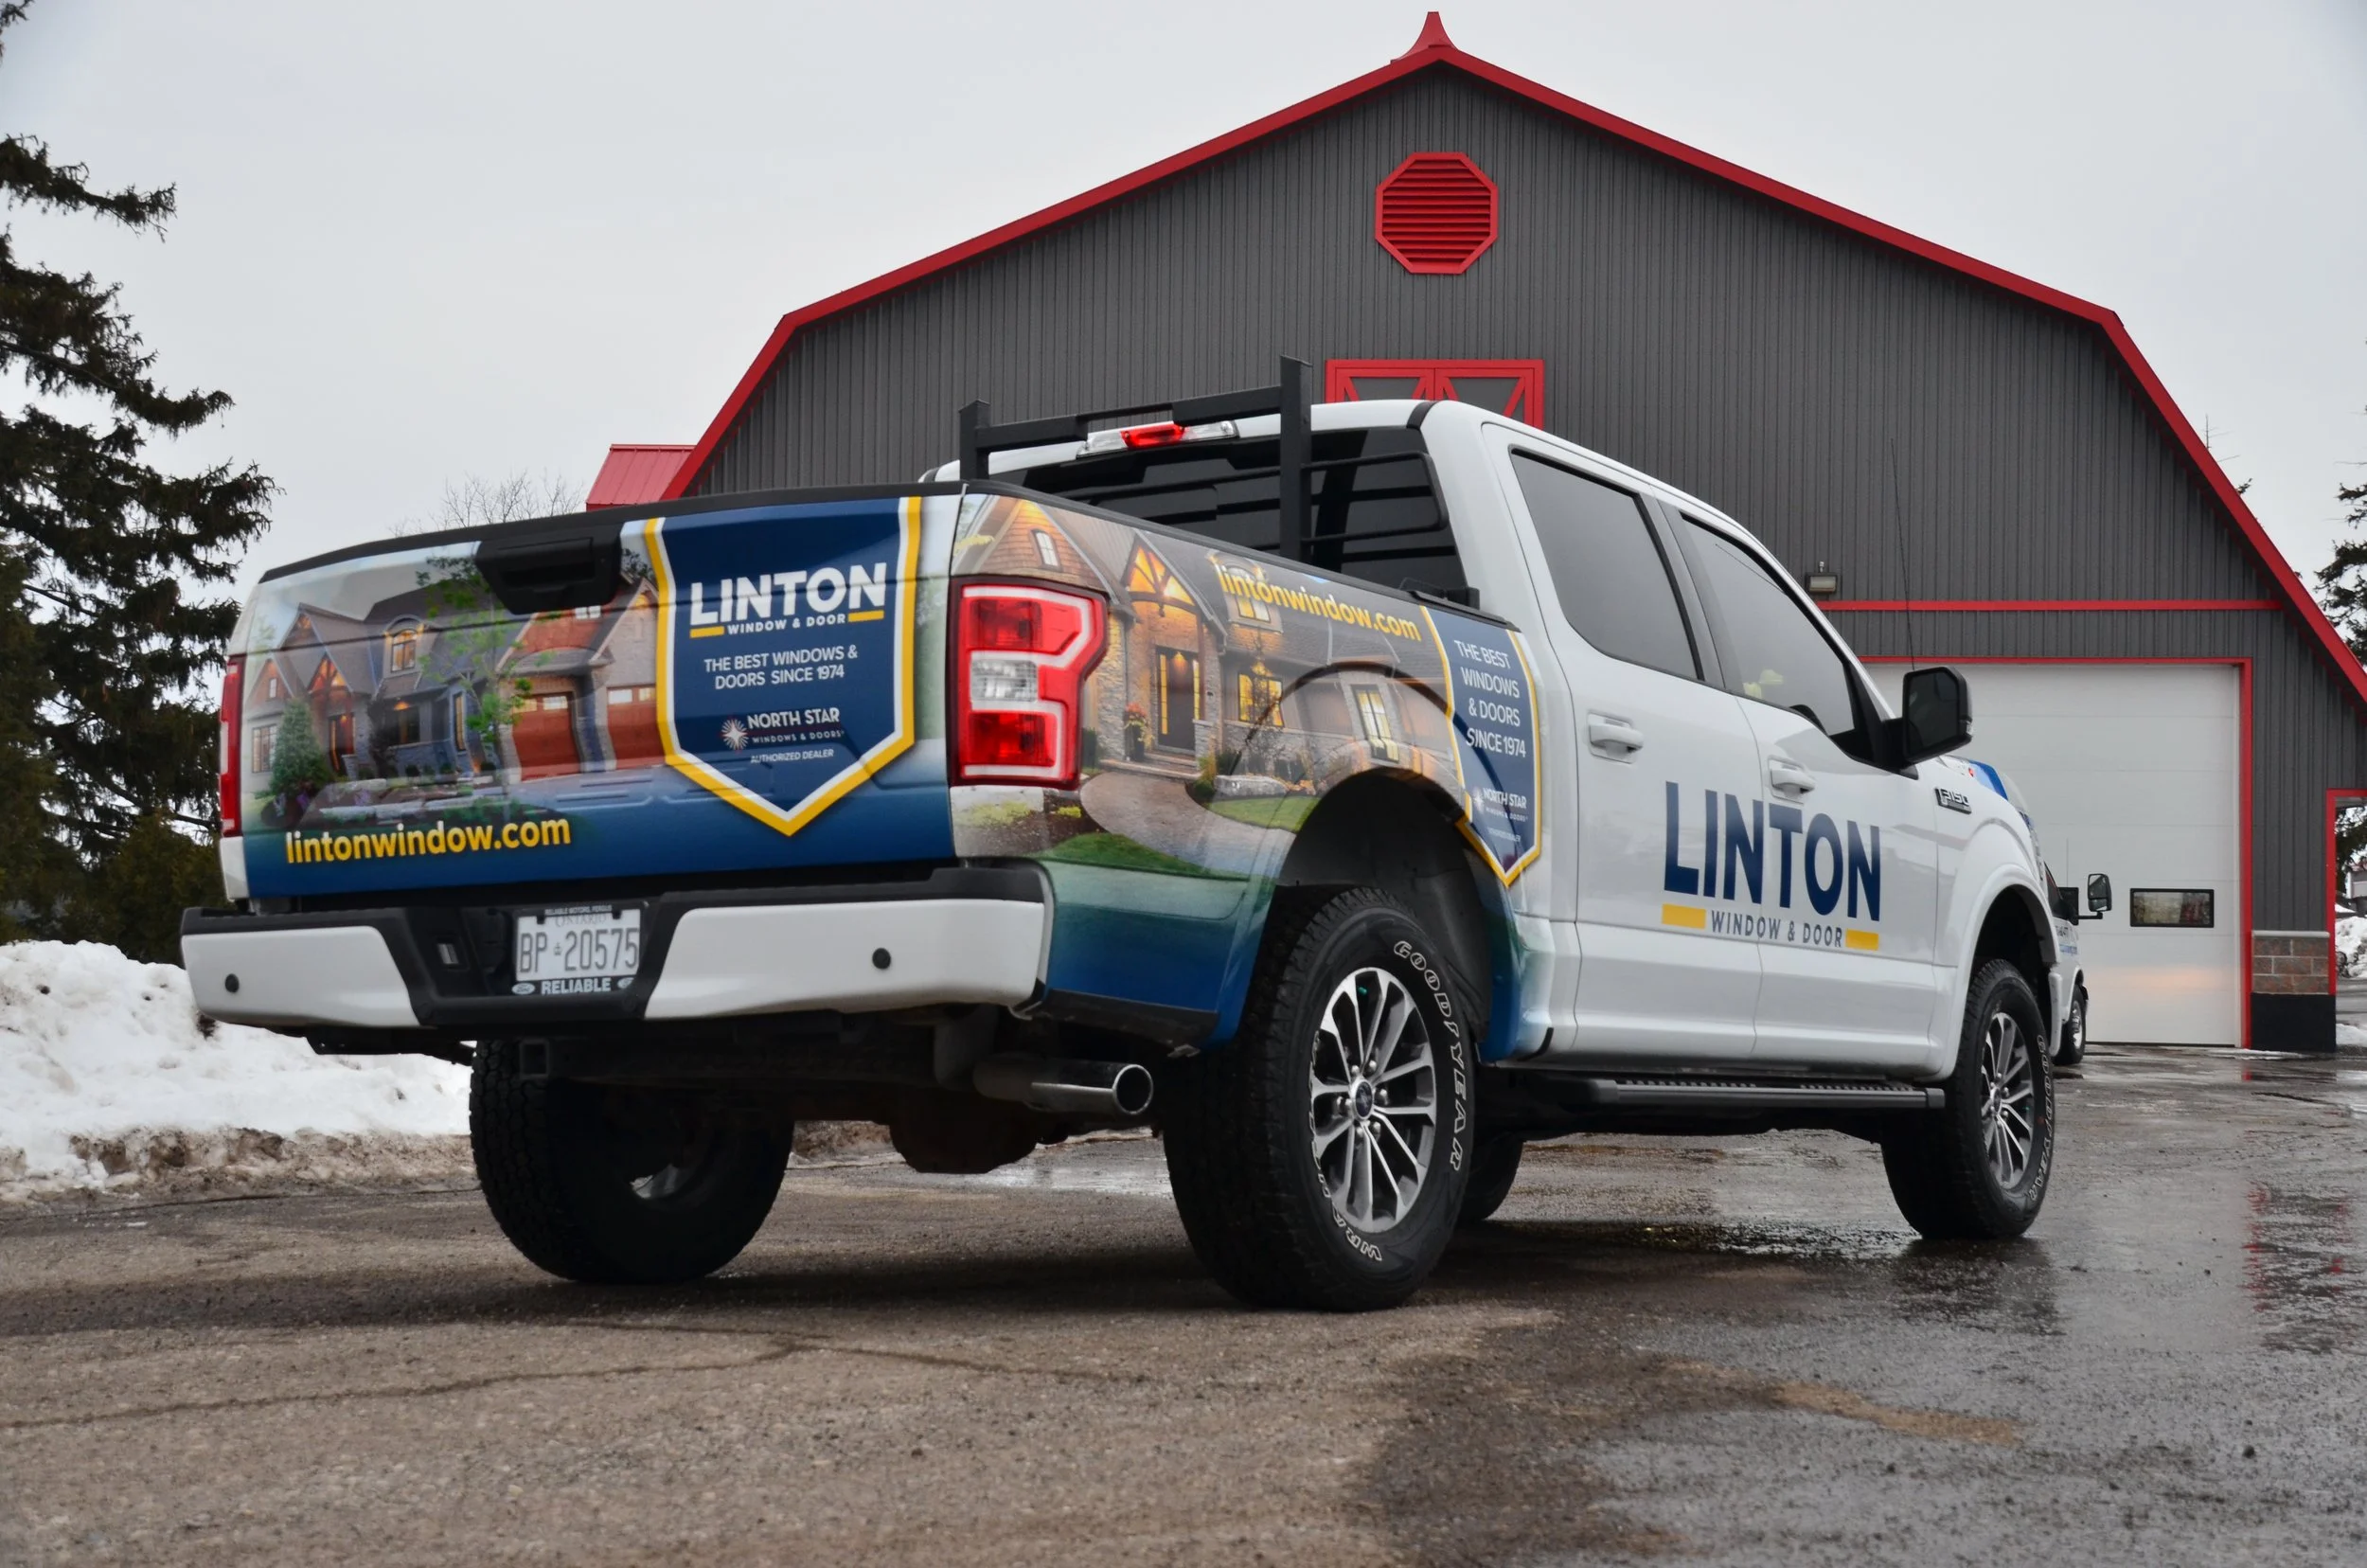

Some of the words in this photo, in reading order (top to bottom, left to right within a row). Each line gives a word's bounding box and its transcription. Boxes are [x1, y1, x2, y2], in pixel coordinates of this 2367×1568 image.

[690, 562, 886, 626] LINTON
[1216, 563, 1422, 641] lintonwindow.com
[727, 618, 787, 635] WINDOW
[792, 617, 801, 629] &
[807, 614, 846, 627] DOOR
[703, 656, 731, 672] THE
[734, 653, 770, 669] BEST
[772, 646, 845, 666] WINDOWS
[847, 644, 858, 659] &
[1453, 639, 1483, 663] THE
[1480, 647, 1511, 669] BEST
[715, 671, 766, 690] DOORS
[771, 667, 813, 685] SINCE
[816, 664, 845, 680] 1974
[1460, 666, 1521, 699] WINDOWS
[747, 710, 802, 730] NORTH
[804, 707, 840, 725] STAR
[1468, 697, 1477, 717] &
[1479, 700, 1521, 727] DOORS
[752, 733, 797, 743] WINDOWS
[1466, 727, 1503, 754] SINCE
[1503, 735, 1526, 758] 1974
[750, 751, 800, 764] AUTHORIZED
[802, 748, 834, 760] DEALER
[1483, 787, 1508, 805] NORTH
[1508, 793, 1527, 810] STAR
[285, 817, 572, 864] lintonwindow.com
[1664, 781, 1881, 921] LINTON
[1711, 910, 1782, 940] WINDOW
[1787, 920, 1796, 942] &
[1803, 922, 1843, 948] DOOR
[520, 932, 548, 973] BP
[564, 928, 639, 971] 20575
[541, 977, 612, 995] RELIABLE
[1394, 940, 1468, 1172] GOODYEAR
